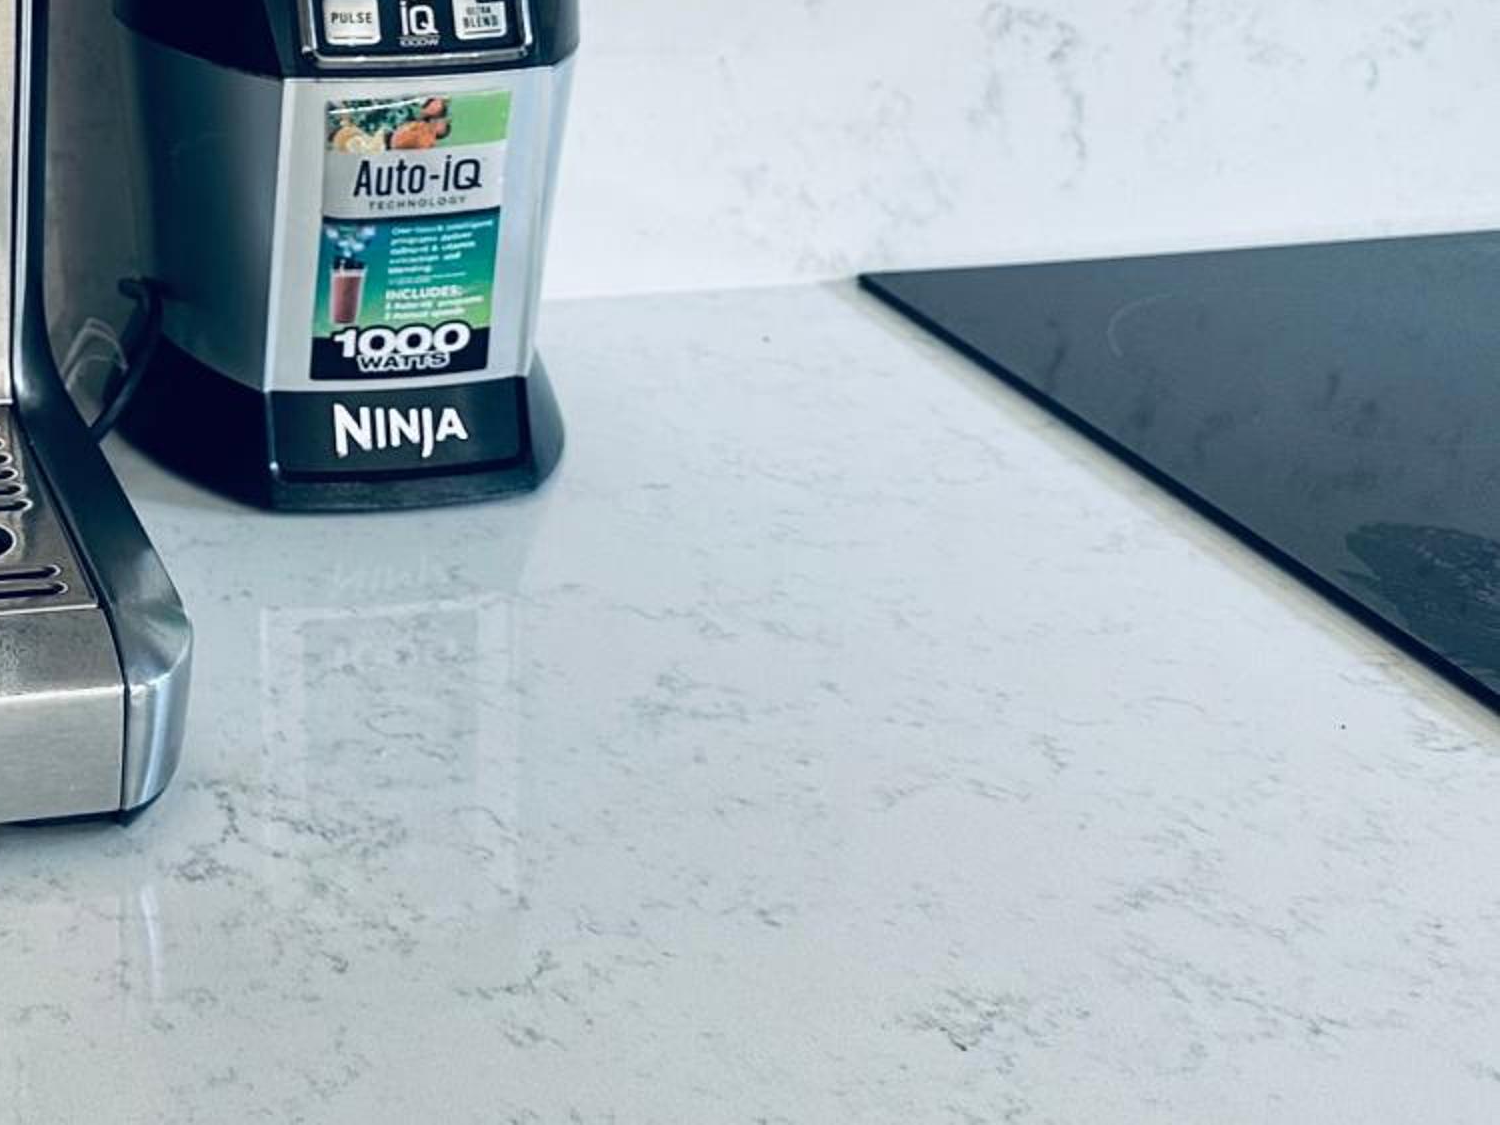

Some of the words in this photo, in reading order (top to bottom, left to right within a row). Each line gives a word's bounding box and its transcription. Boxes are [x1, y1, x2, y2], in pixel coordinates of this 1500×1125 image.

[331, 12, 373, 24] PULSE
[400, 1, 439, 36] iQ
[462, 16, 498, 28] BLEND
[353, 154, 482, 197] Auto-iQ
[369, 196, 467, 211] TECHNOLOGY
[334, 322, 471, 358] 1000
[358, 352, 450, 372] WATTS
[333, 403, 468, 458] NINJA
